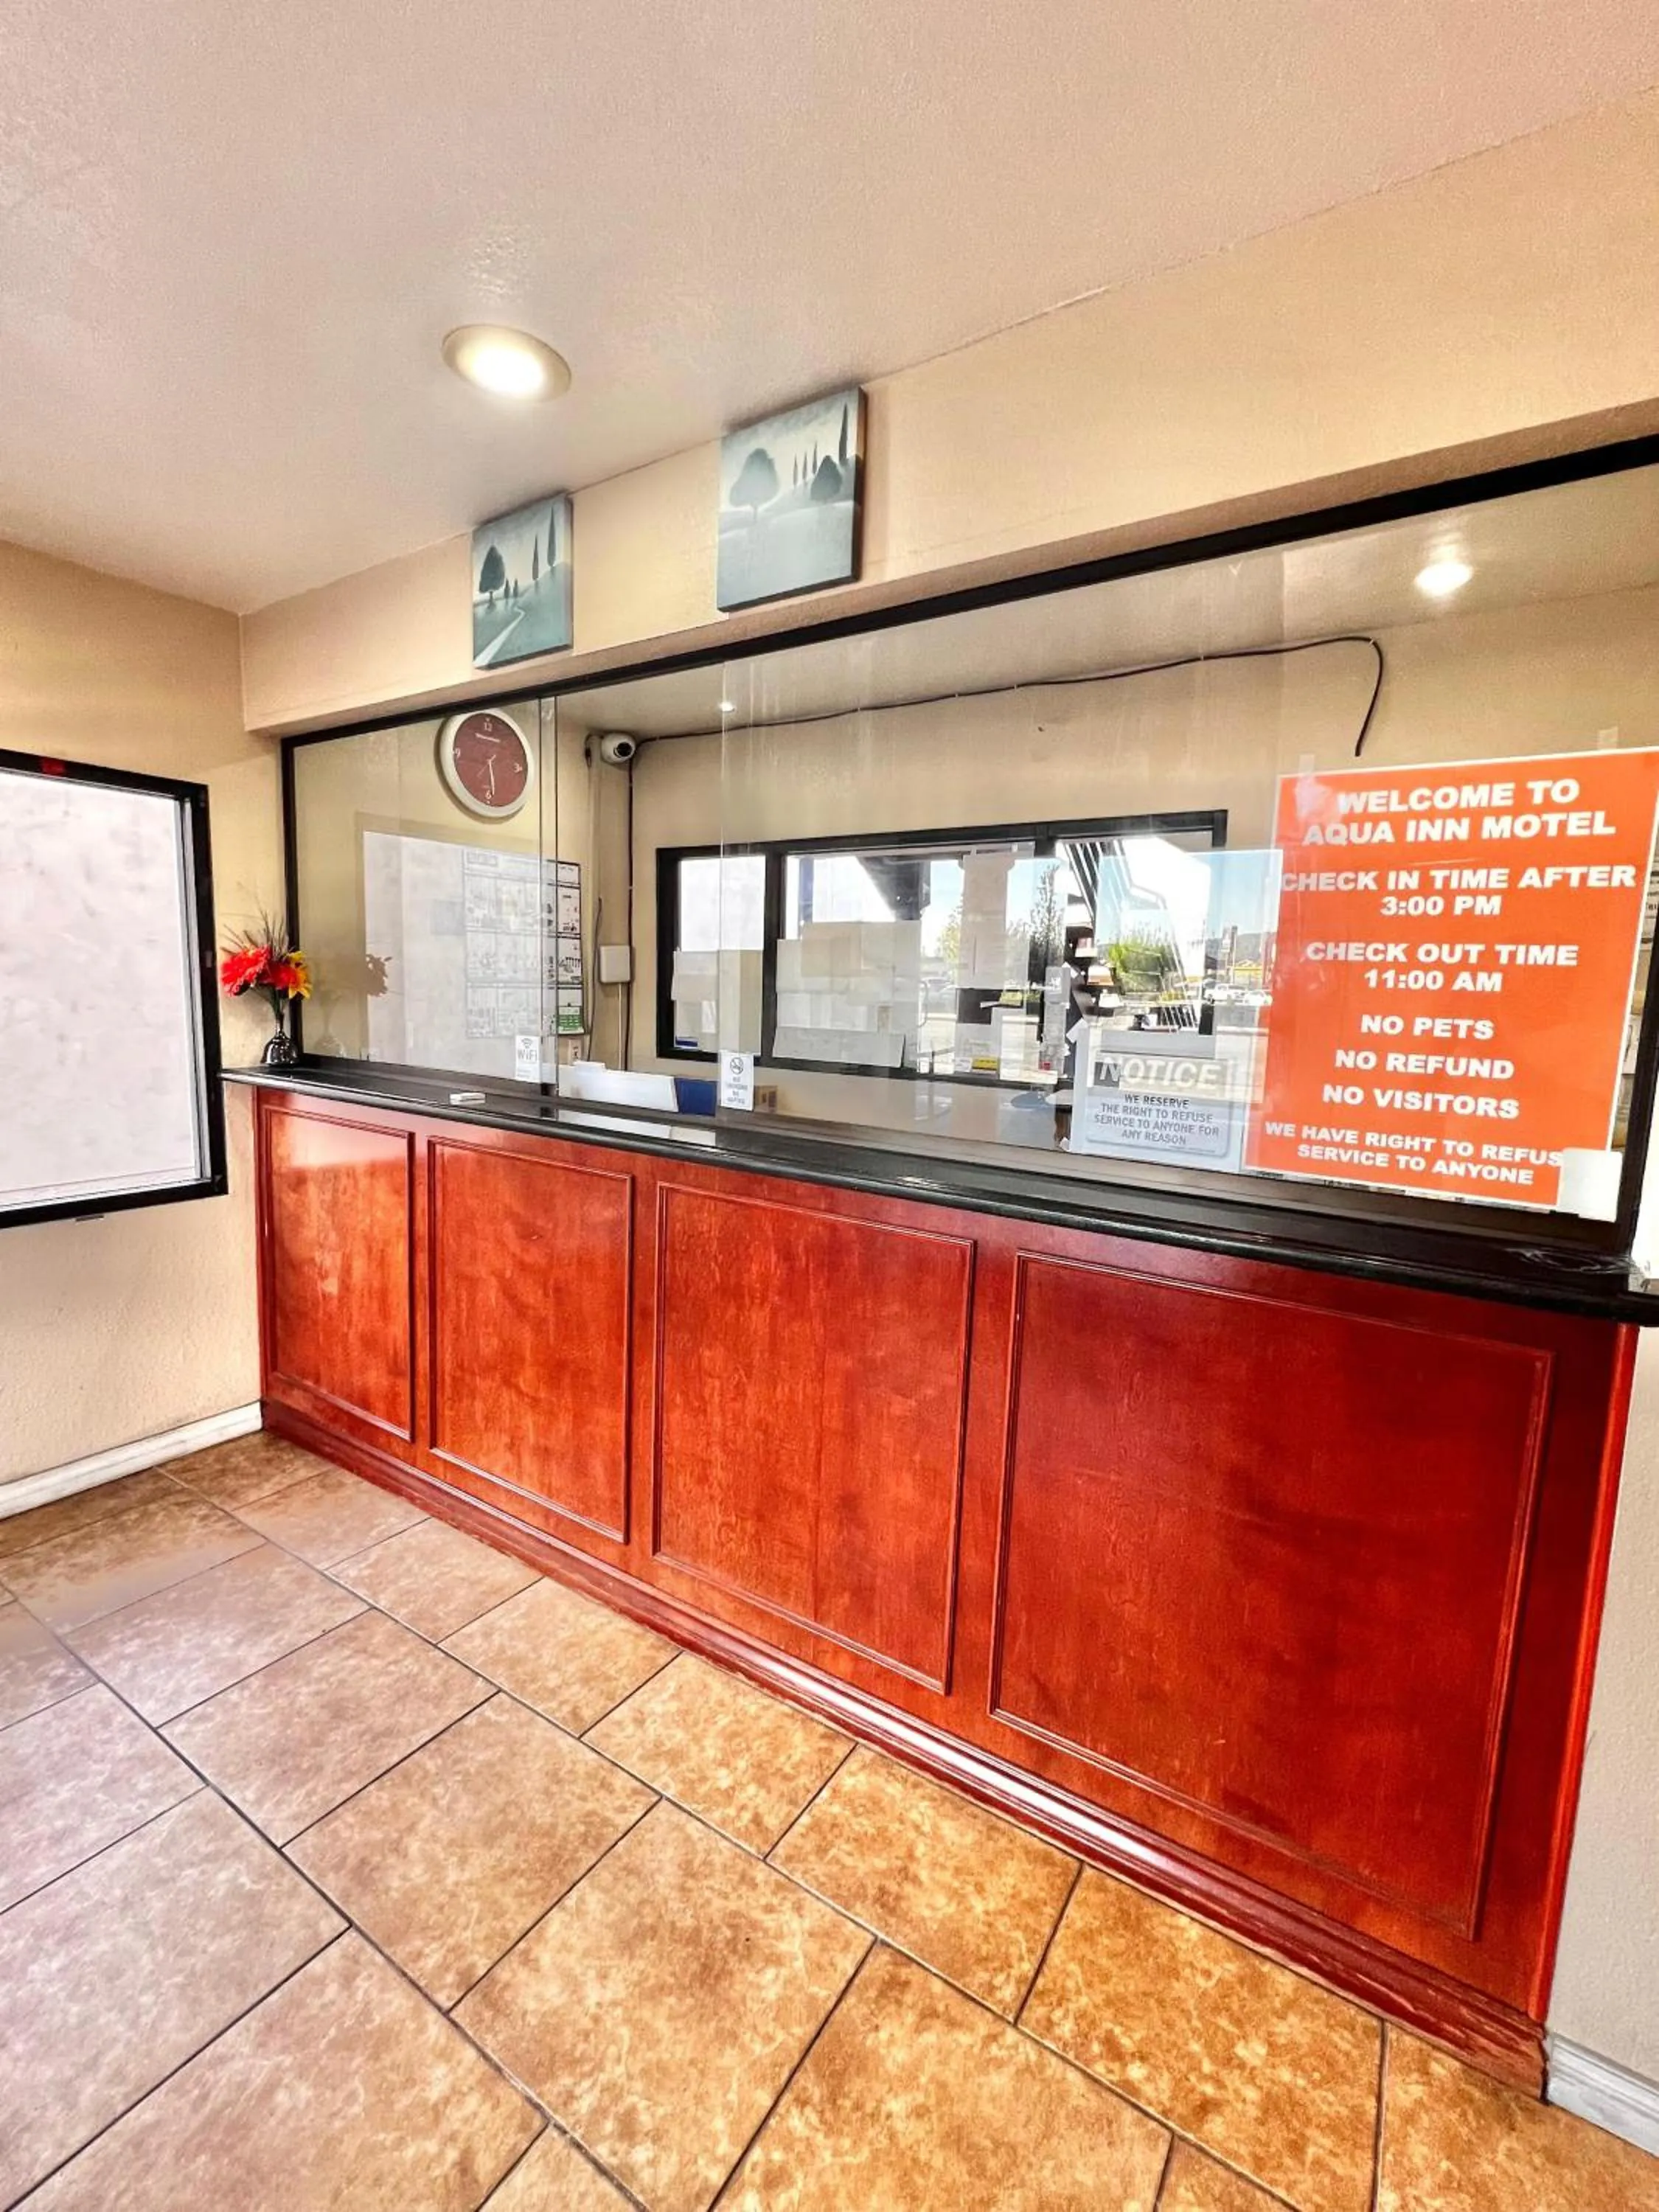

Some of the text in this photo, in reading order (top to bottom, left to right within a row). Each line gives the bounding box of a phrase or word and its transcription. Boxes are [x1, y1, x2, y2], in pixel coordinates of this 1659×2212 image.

[1338, 778, 1580, 815] WELCOME TO
[1301, 811, 1616, 847] AQUA INN MOTEL
[1281, 864, 1637, 892] CHECK IN TIME AFTER
[1380, 895, 1501, 916] 3:00 PM
[1306, 942, 1579, 967] CHECK OUT TIME
[1364, 970, 1503, 992] 11:00 AM
[1361, 1015, 1495, 1040] NO PETS
[1099, 1057, 1222, 1091] NOTICE
[1335, 1049, 1515, 1079] NO REFUND
[1101, 1103, 1214, 1124] THE RIGHT TO REFUSE
[1124, 1094, 1190, 1109] WE RESERVE
[1322, 1085, 1520, 1119] NO VISITORS
[1094, 1114, 1219, 1136] SERVICE TO ANYONE FOR
[1121, 1130, 1186, 1144] ANY REASON
[1265, 1121, 1563, 1167] WE HAVE RIGHT TO REFUS
[1298, 1144, 1534, 1186] SERVICE TO ANYONE
